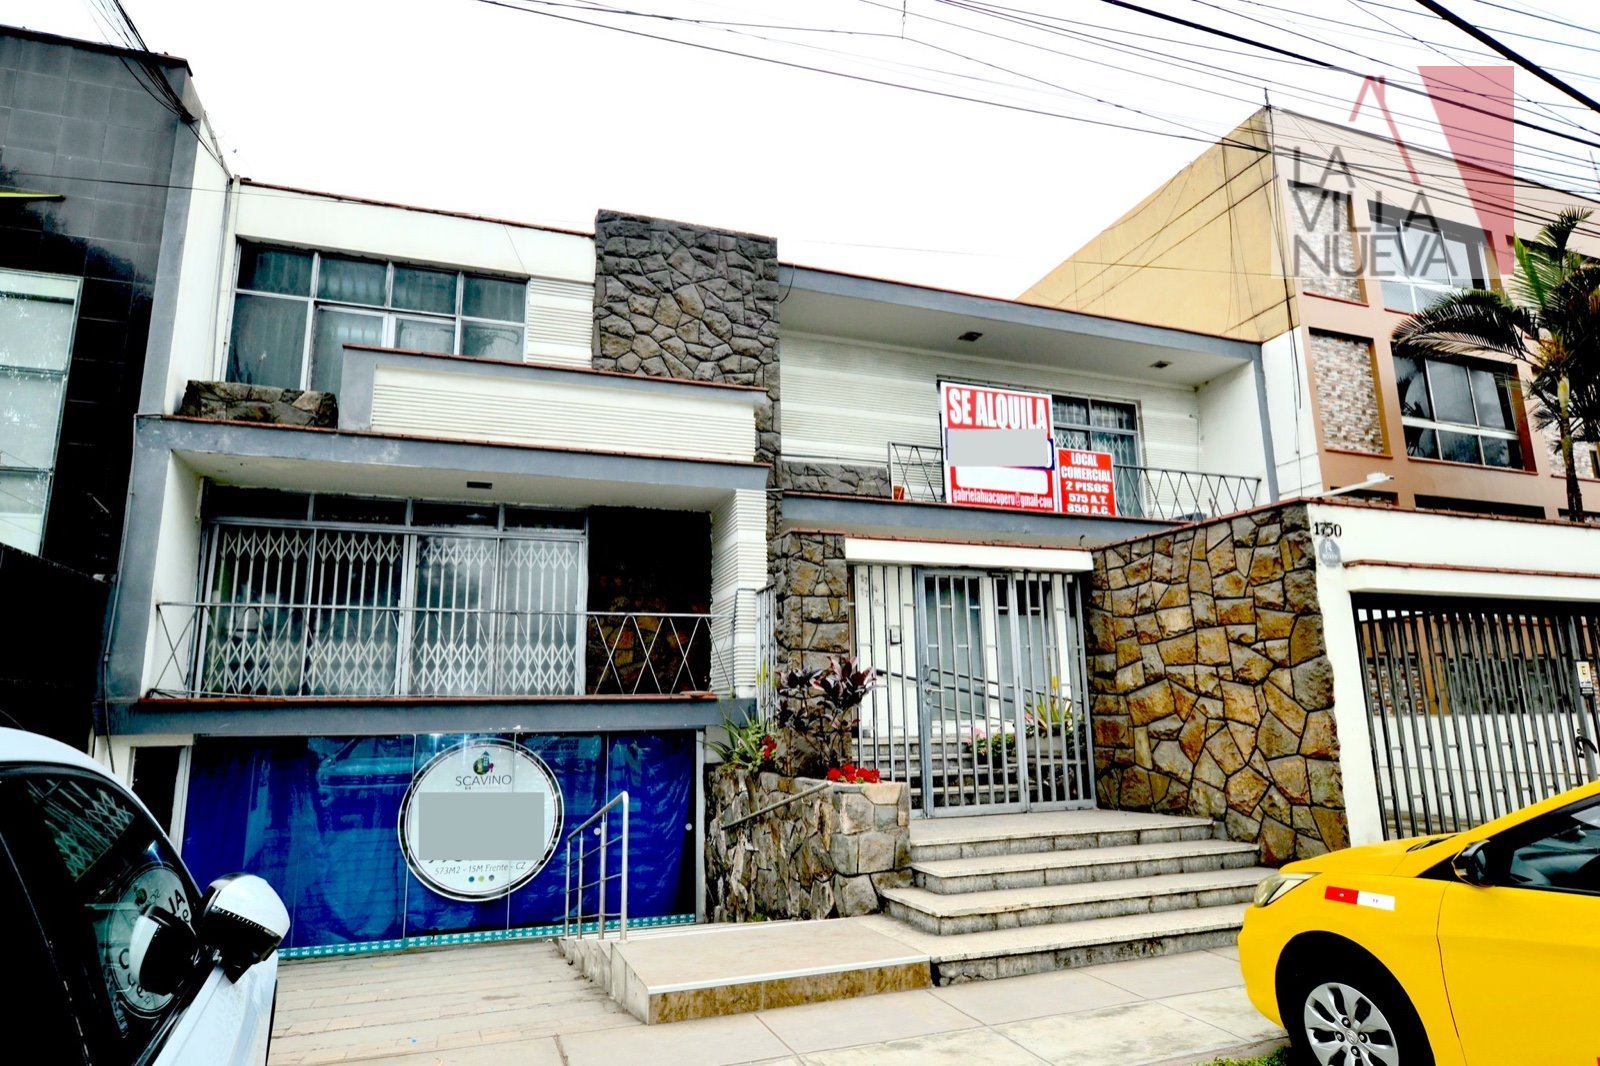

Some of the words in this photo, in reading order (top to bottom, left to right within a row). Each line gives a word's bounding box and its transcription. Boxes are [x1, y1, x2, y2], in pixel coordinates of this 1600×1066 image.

[949, 388, 973, 426] SE
[974, 391, 1048, 430] ALQUILA
[1070, 452, 1099, 467] LOCAL
[1060, 465, 1112, 483] COMERCIAL
[1065, 480, 1073, 491] 2
[1075, 481, 1110, 494] PISOS
[1068, 493, 1089, 504] 575
[1090, 494, 1108, 505] A.T.
[1066, 503, 1090, 514] 850
[1314, 521, 1342, 538] 1750
[455, 774, 512, 787] SCAVINO
[468, 864, 484, 873] 15M
[485, 863, 509, 872] Frente
